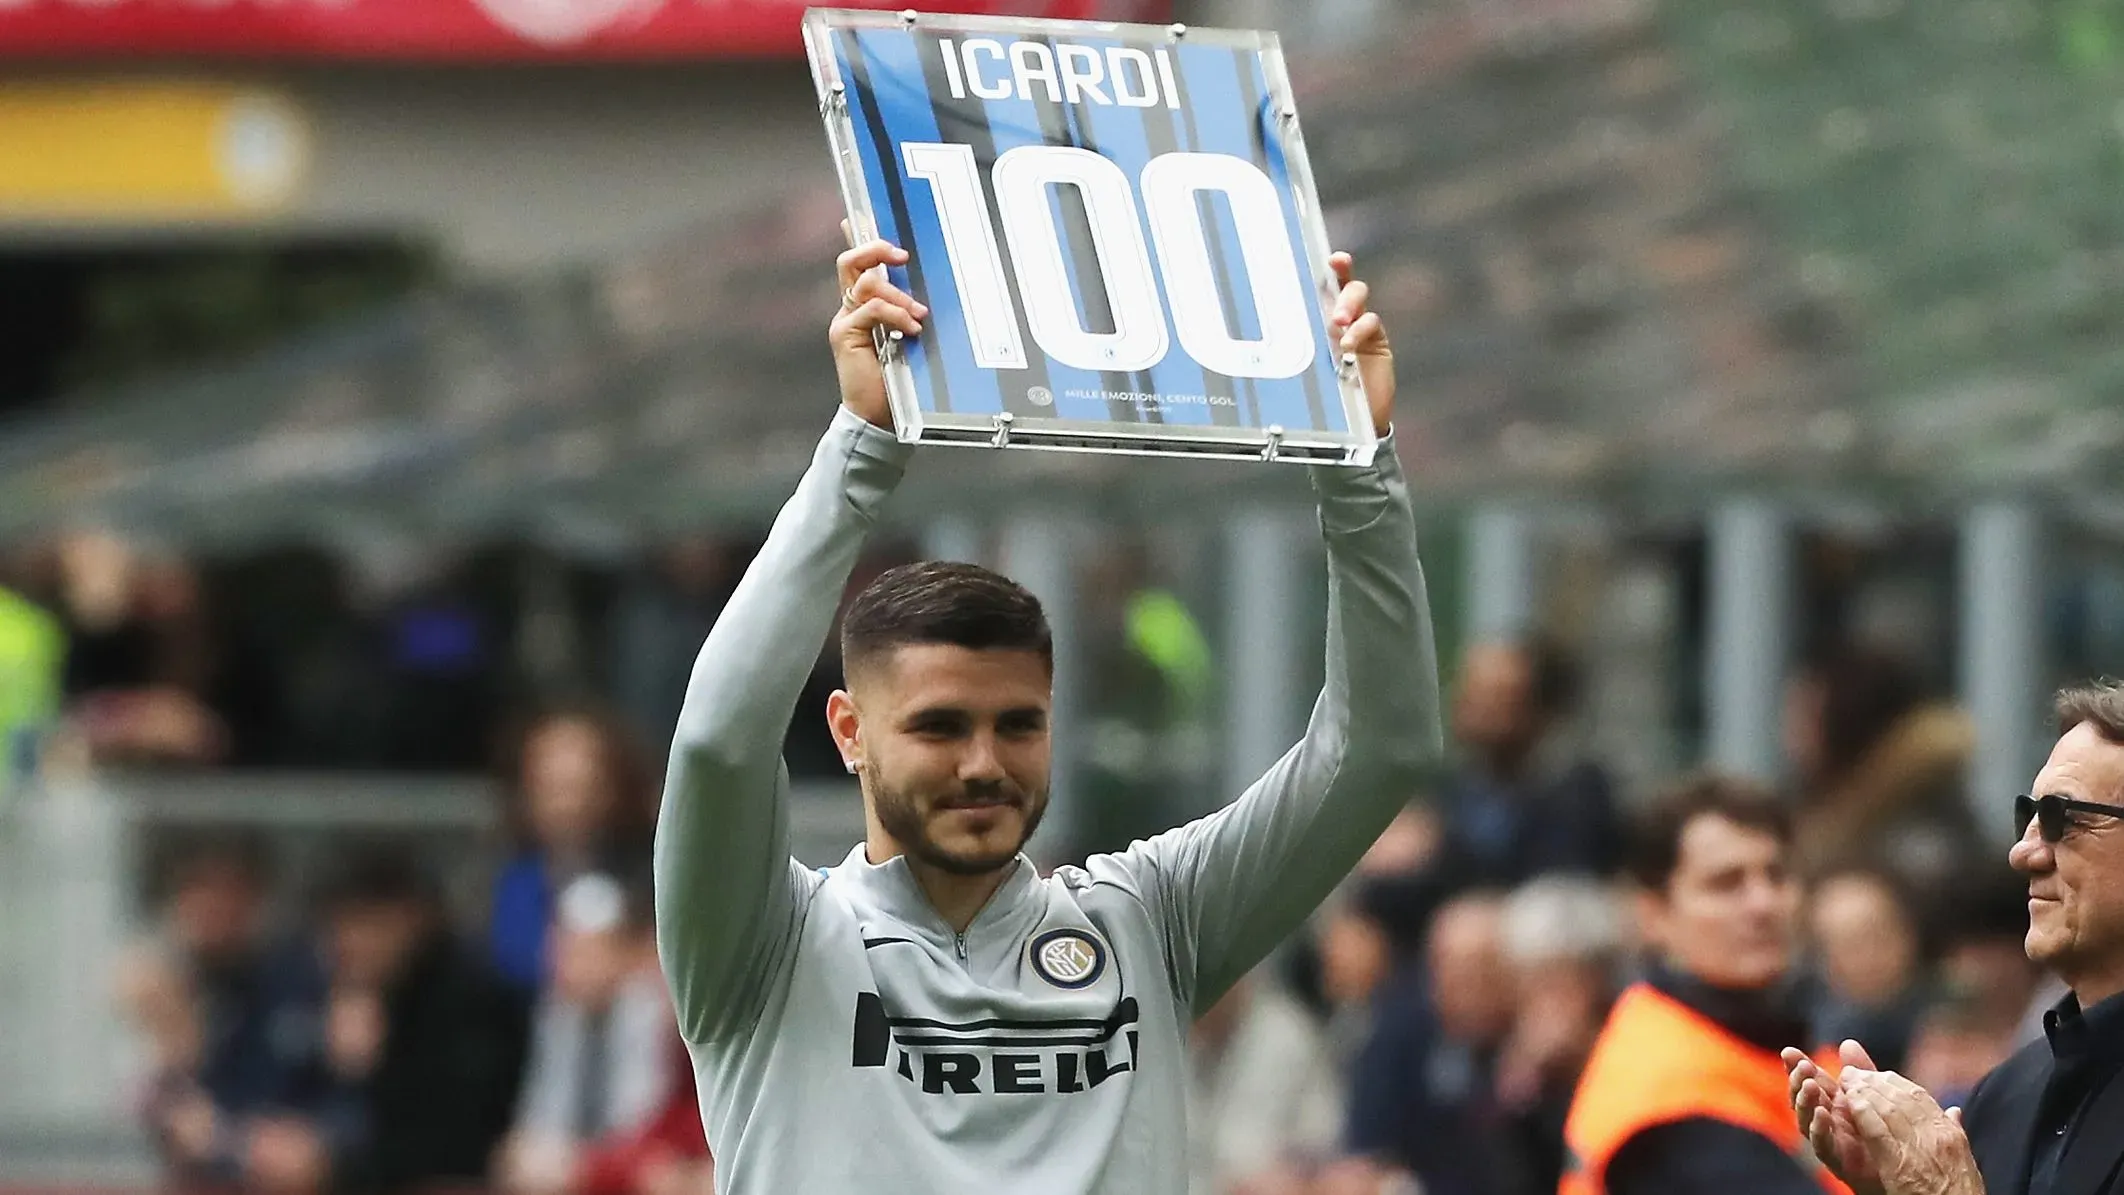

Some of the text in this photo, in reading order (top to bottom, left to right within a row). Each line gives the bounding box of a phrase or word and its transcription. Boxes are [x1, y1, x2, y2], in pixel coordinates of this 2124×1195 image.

[939, 38, 1182, 109] ICARDI
[900, 141, 1316, 379] 100
[1065, 389, 1100, 400] MILLE
[1166, 393, 1207, 405] CENTO
